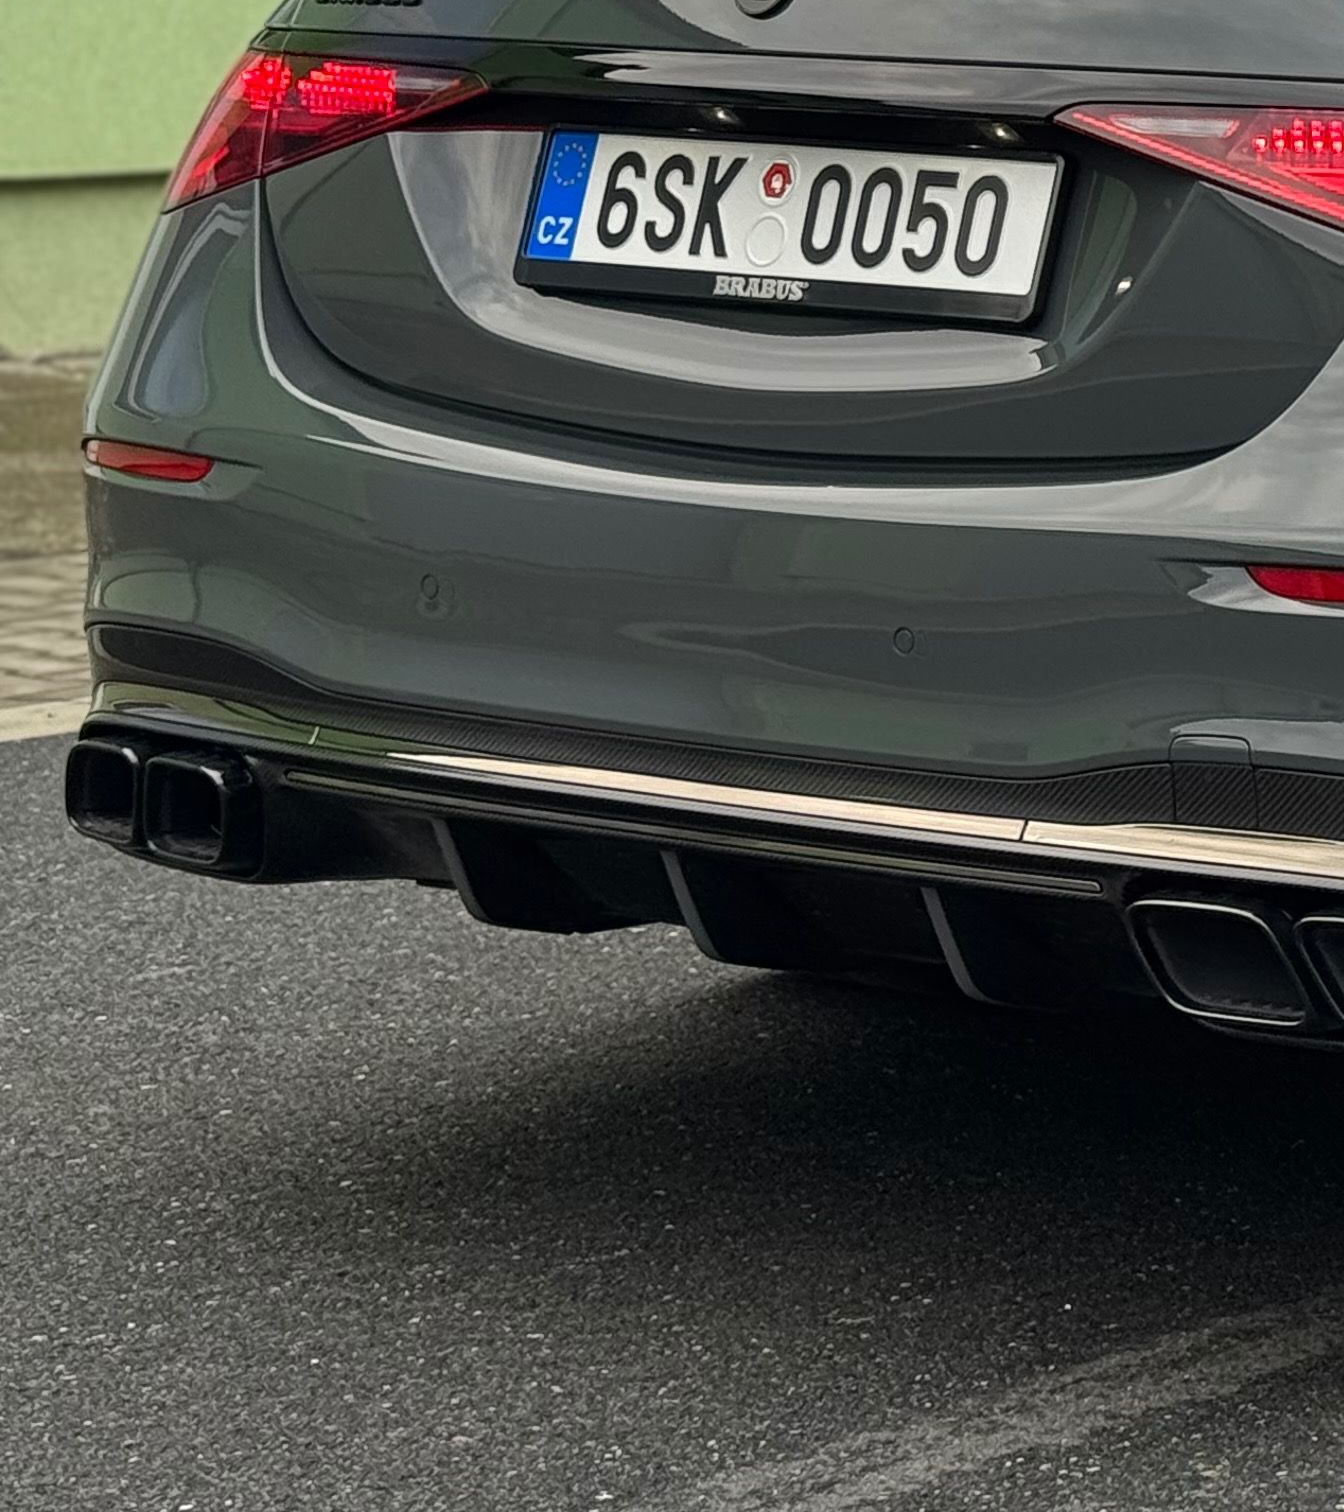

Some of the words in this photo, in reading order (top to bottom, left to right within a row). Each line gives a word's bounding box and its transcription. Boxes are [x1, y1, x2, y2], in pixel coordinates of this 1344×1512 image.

[597, 151, 747, 257] 6SK
[801, 164, 1009, 277] 0050
[537, 216, 573, 246] CZ
[713, 275, 809, 301] BRABUS
